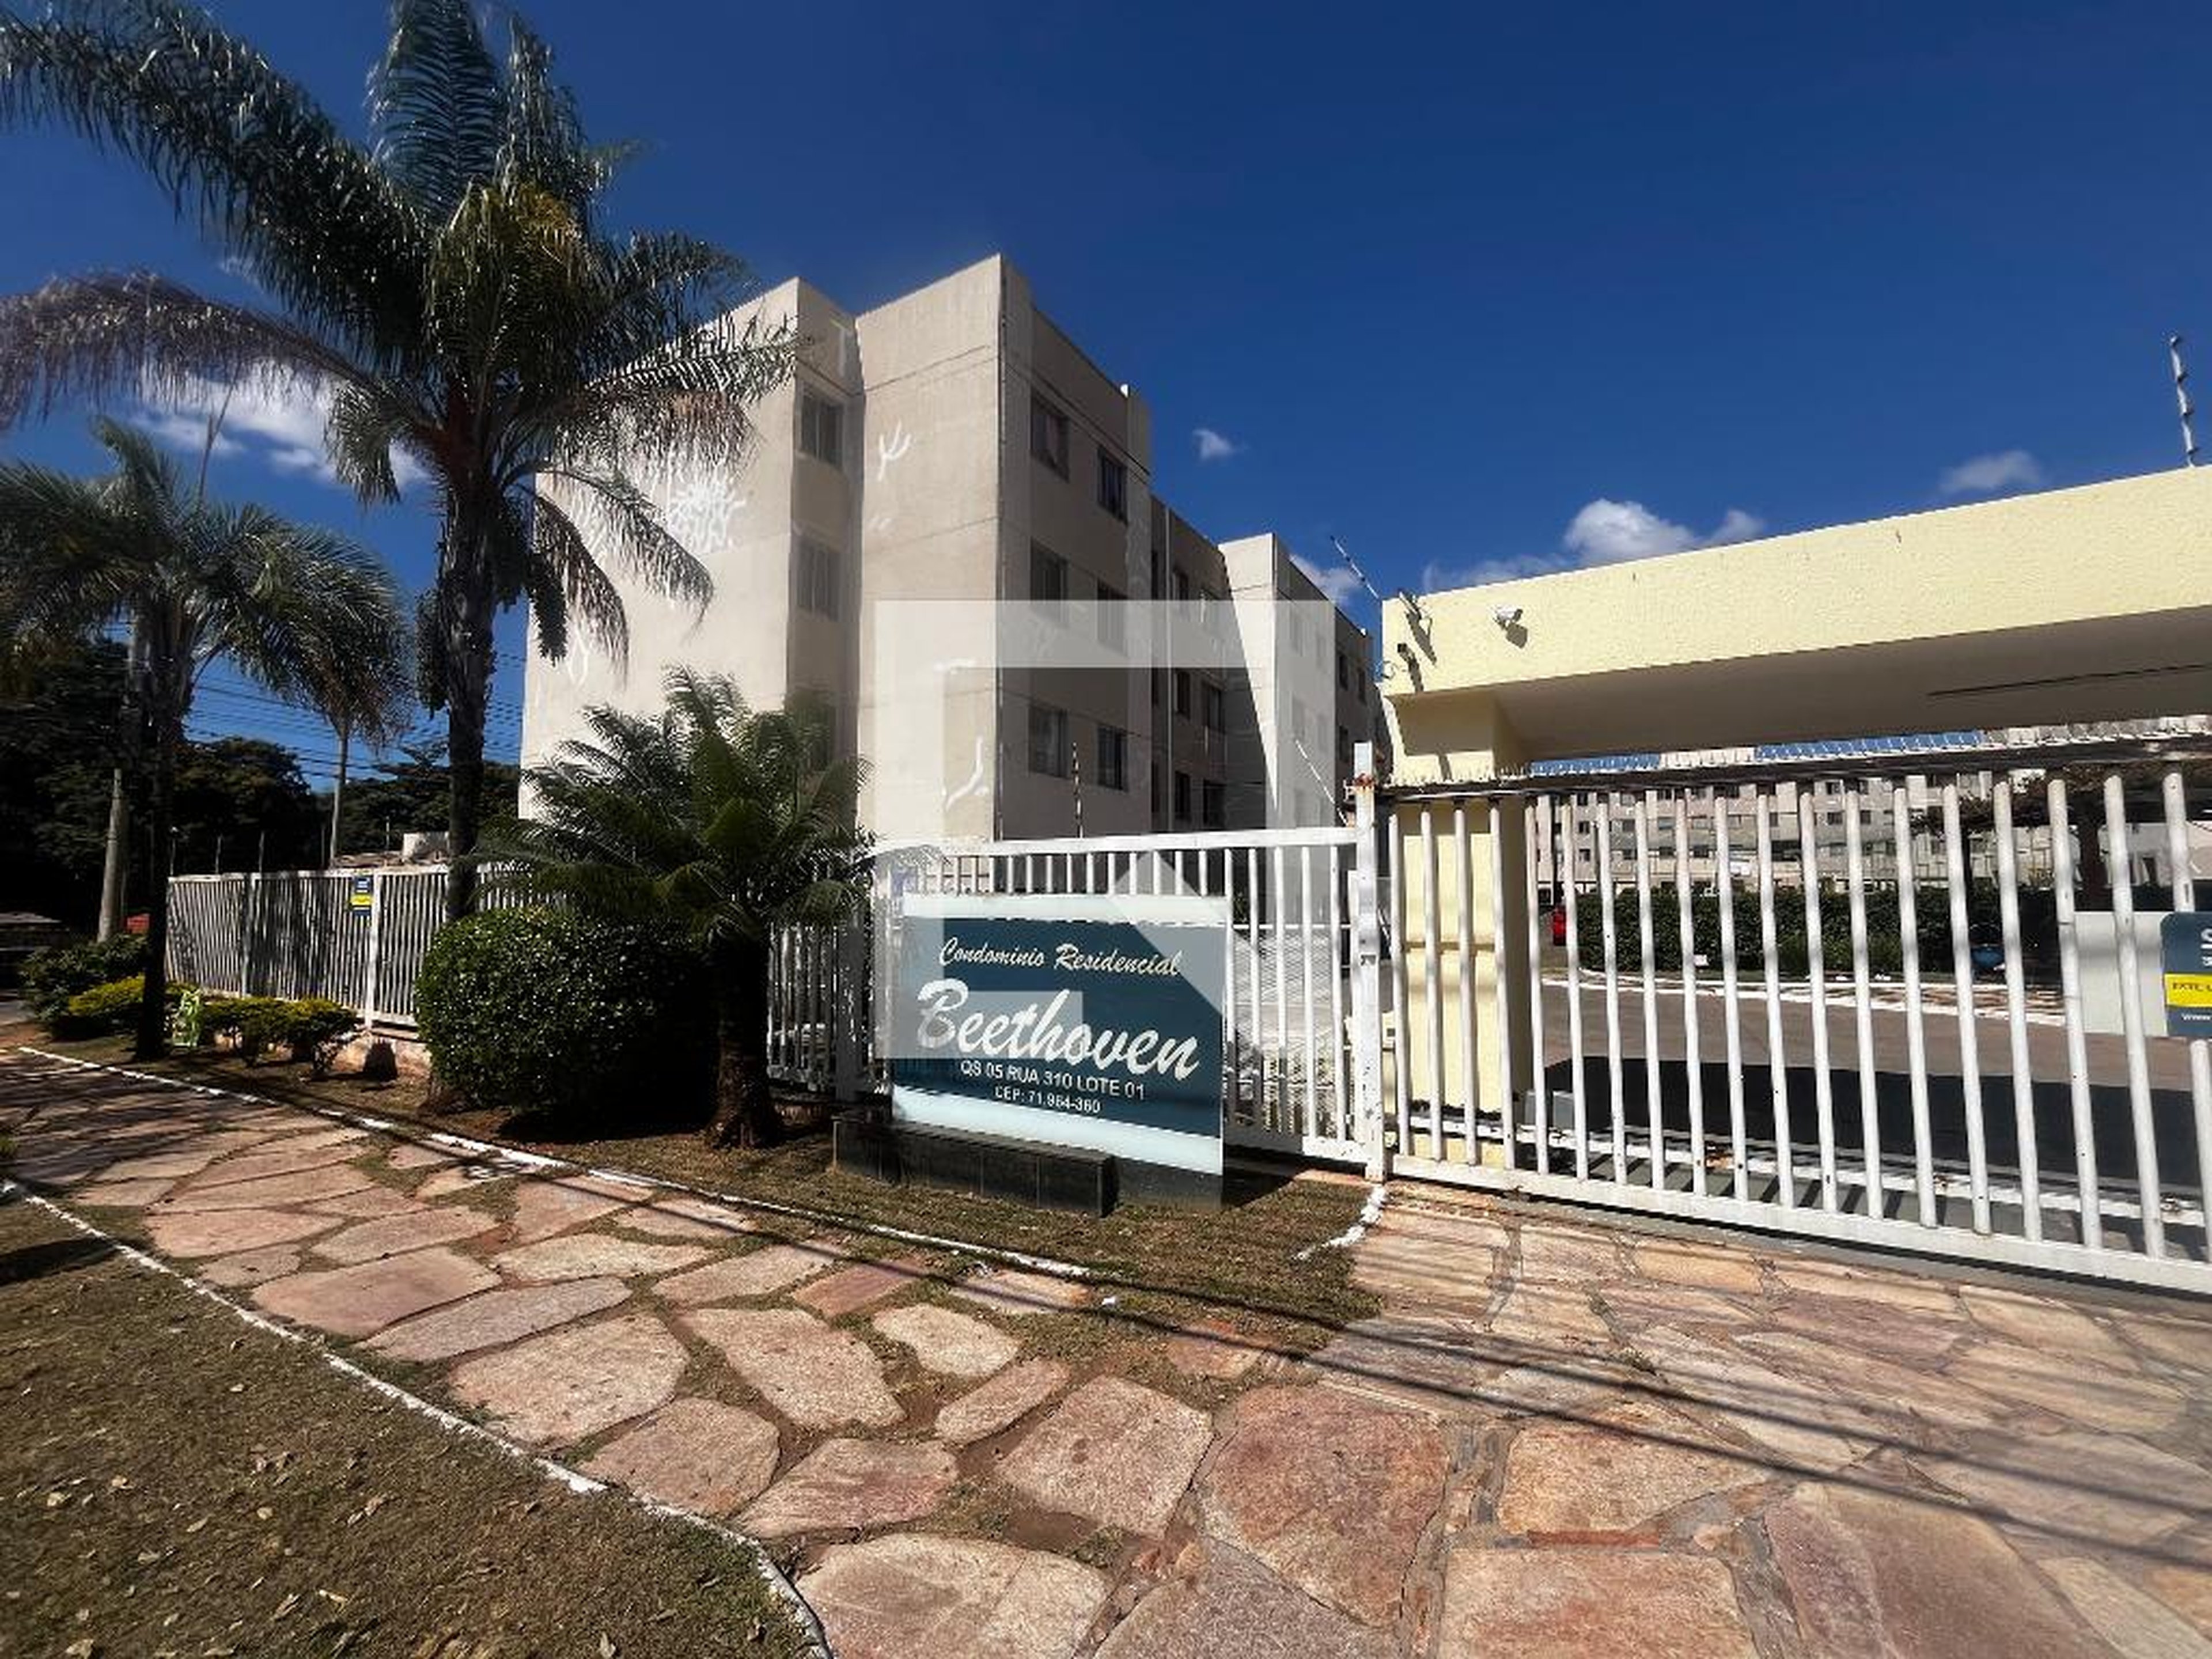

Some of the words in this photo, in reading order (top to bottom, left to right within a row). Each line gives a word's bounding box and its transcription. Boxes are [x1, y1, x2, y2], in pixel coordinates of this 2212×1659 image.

[1055, 943, 1182, 976] Residencial
[918, 978, 1199, 1080] Beethoven
[960, 1060, 982, 1077] QS
[986, 1062, 1003, 1078] 05
[1006, 1065, 1039, 1085] RUA
[1043, 1070, 1072, 1089] 310
[1077, 1075, 1120, 1096] LOTE
[1125, 1081, 1144, 1100] 01
[995, 1086, 1025, 1102] CEP:
